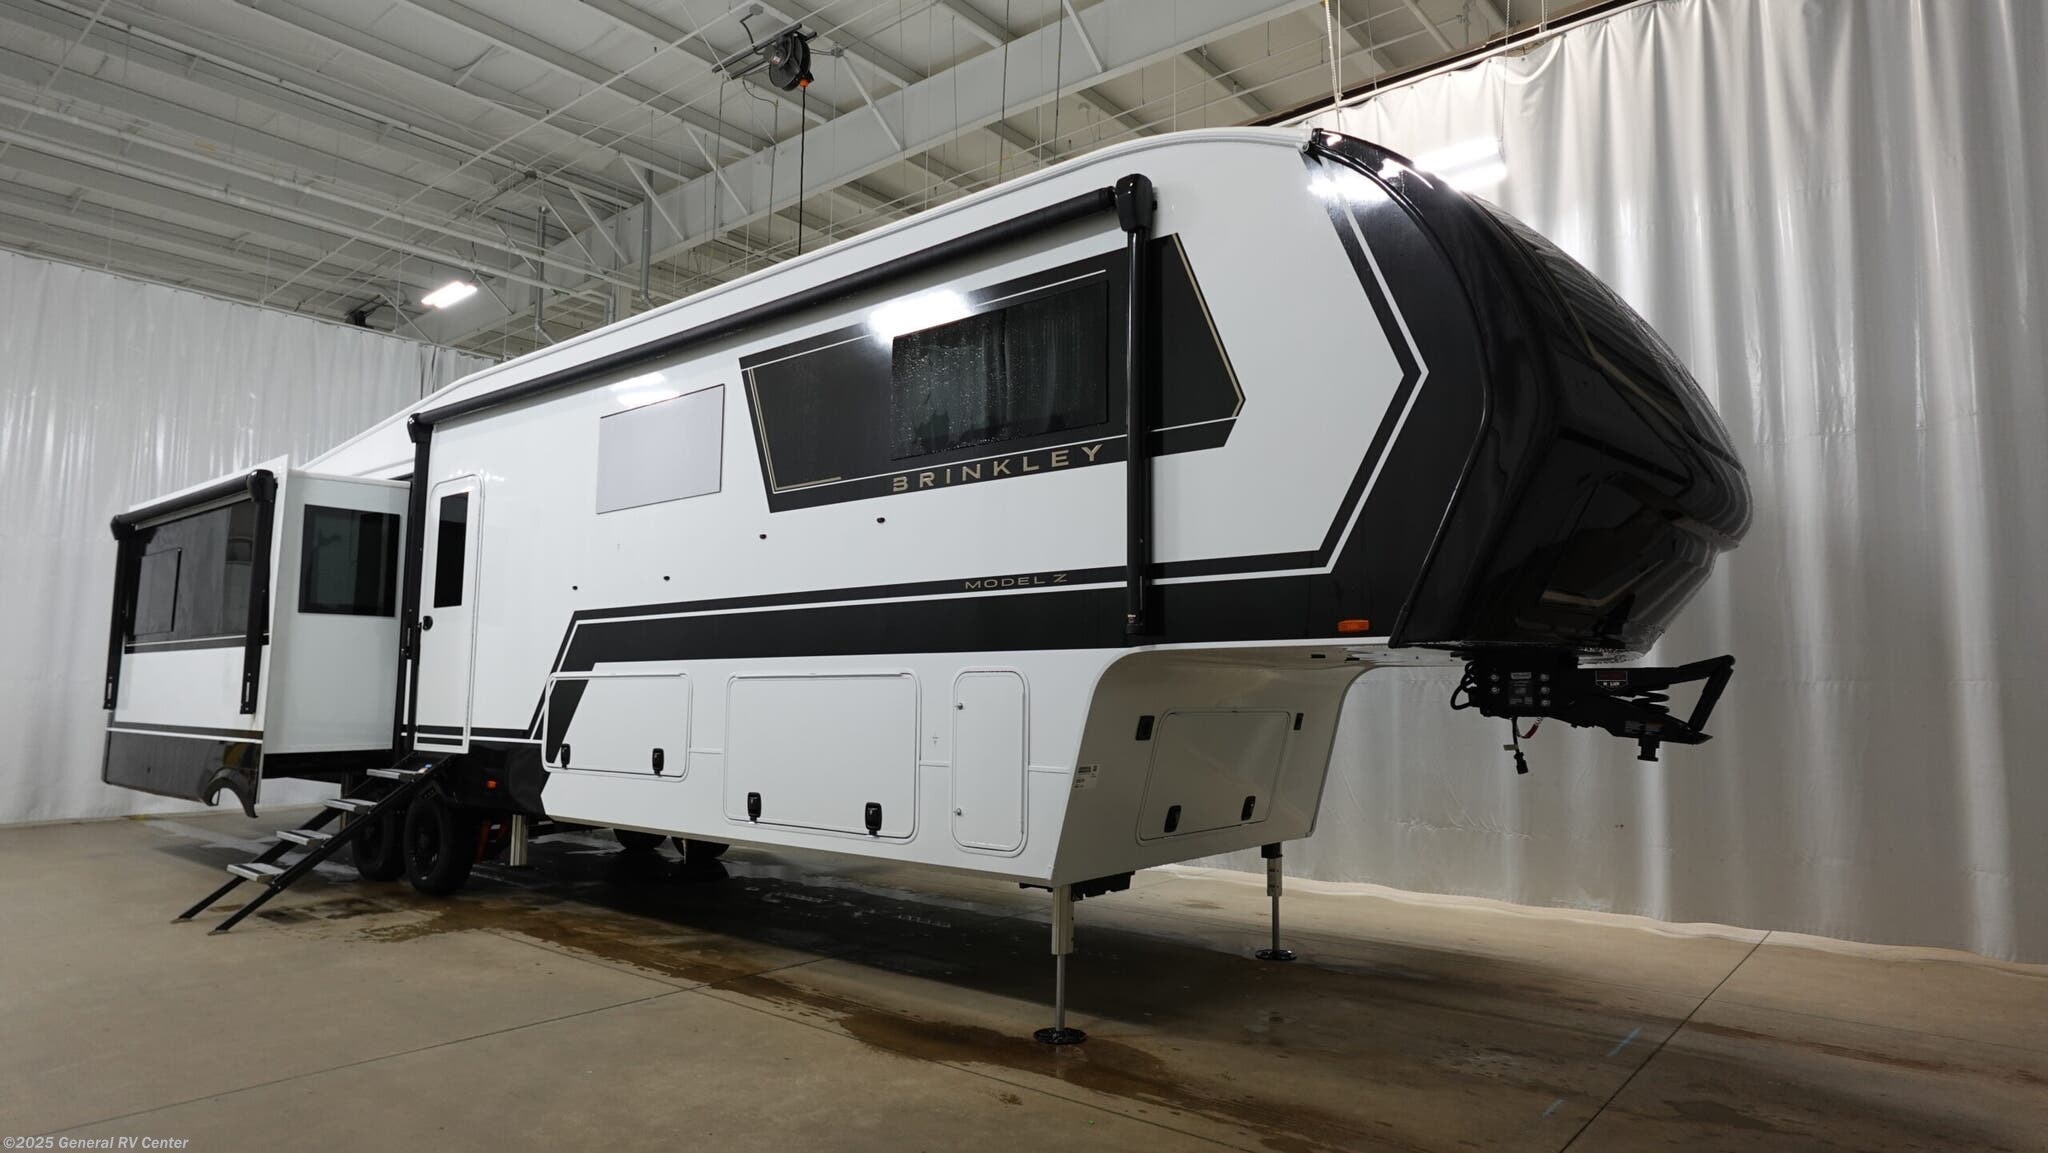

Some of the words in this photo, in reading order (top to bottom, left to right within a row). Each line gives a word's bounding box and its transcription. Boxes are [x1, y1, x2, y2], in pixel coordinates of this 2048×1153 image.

[892, 444, 1102, 492] BRINKLEY
[965, 576, 1045, 590] MODEL
[1053, 573, 1068, 583] Z
